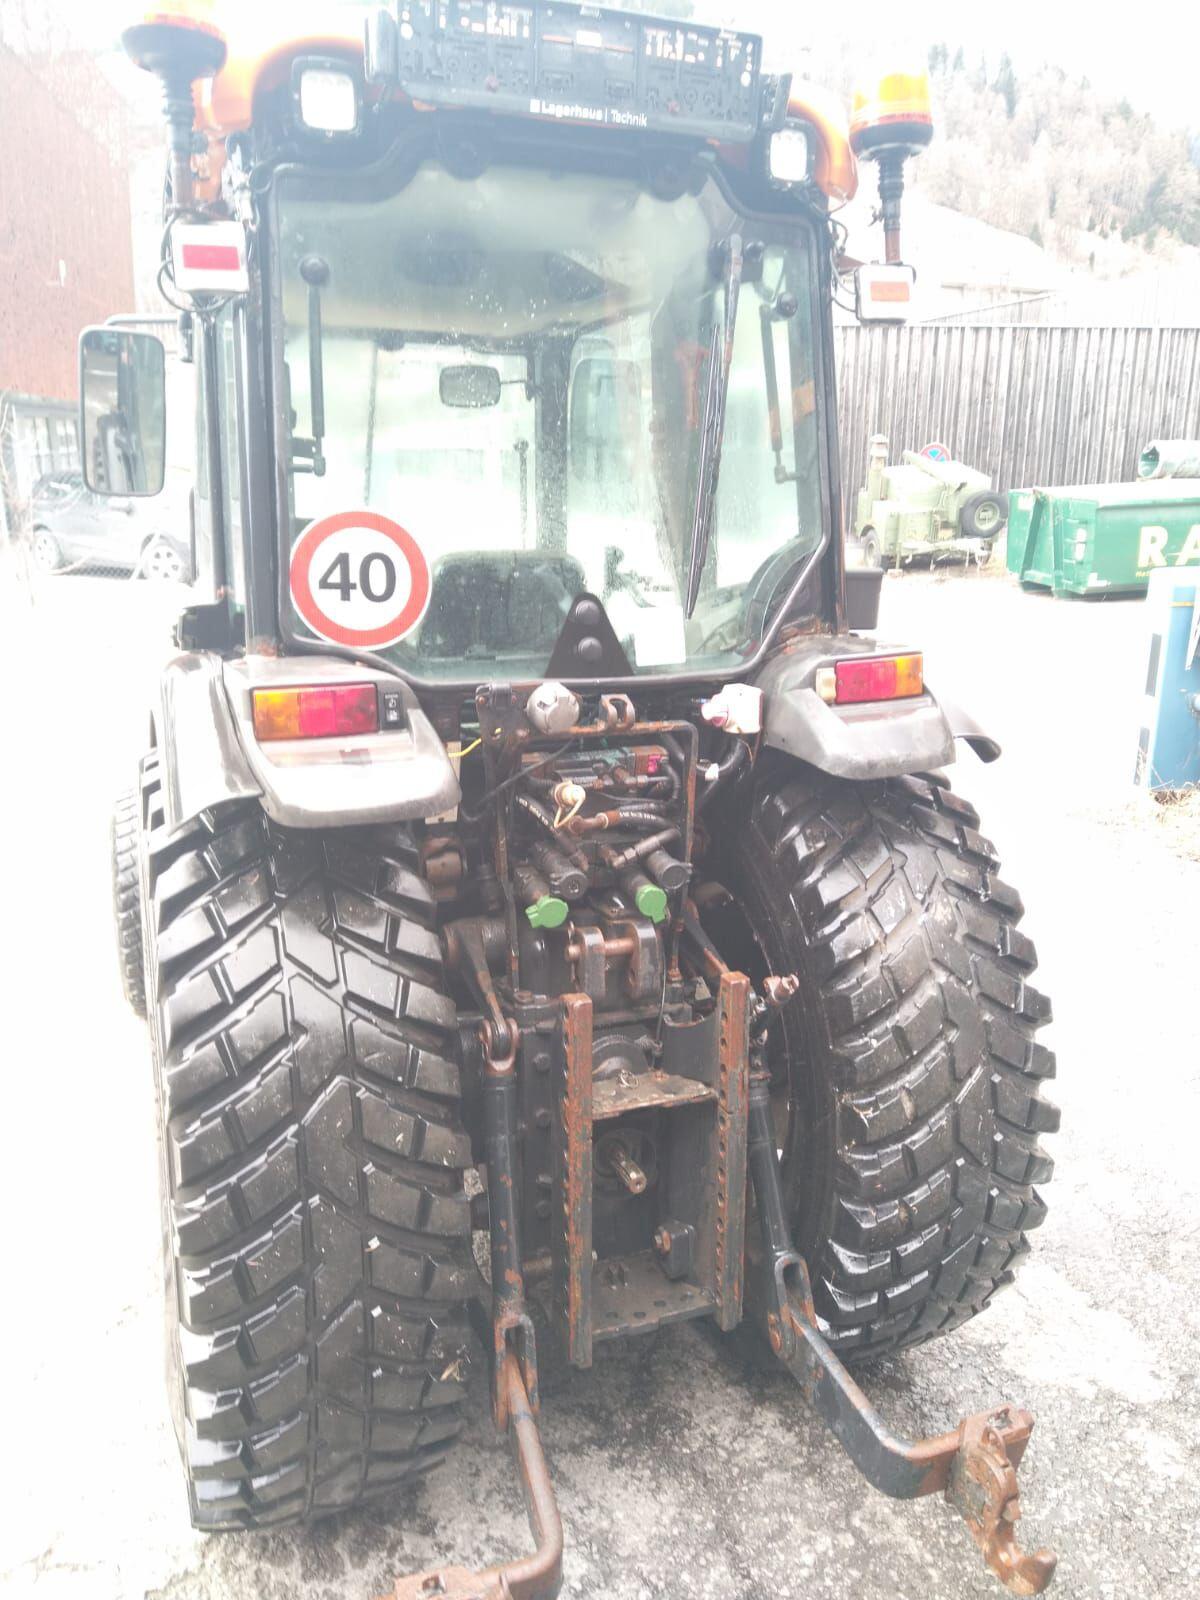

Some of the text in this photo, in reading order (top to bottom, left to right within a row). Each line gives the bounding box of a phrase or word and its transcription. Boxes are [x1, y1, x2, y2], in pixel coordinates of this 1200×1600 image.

[541, 101, 648, 127] Lagerhaus Technik
[318, 552, 397, 603] 40
